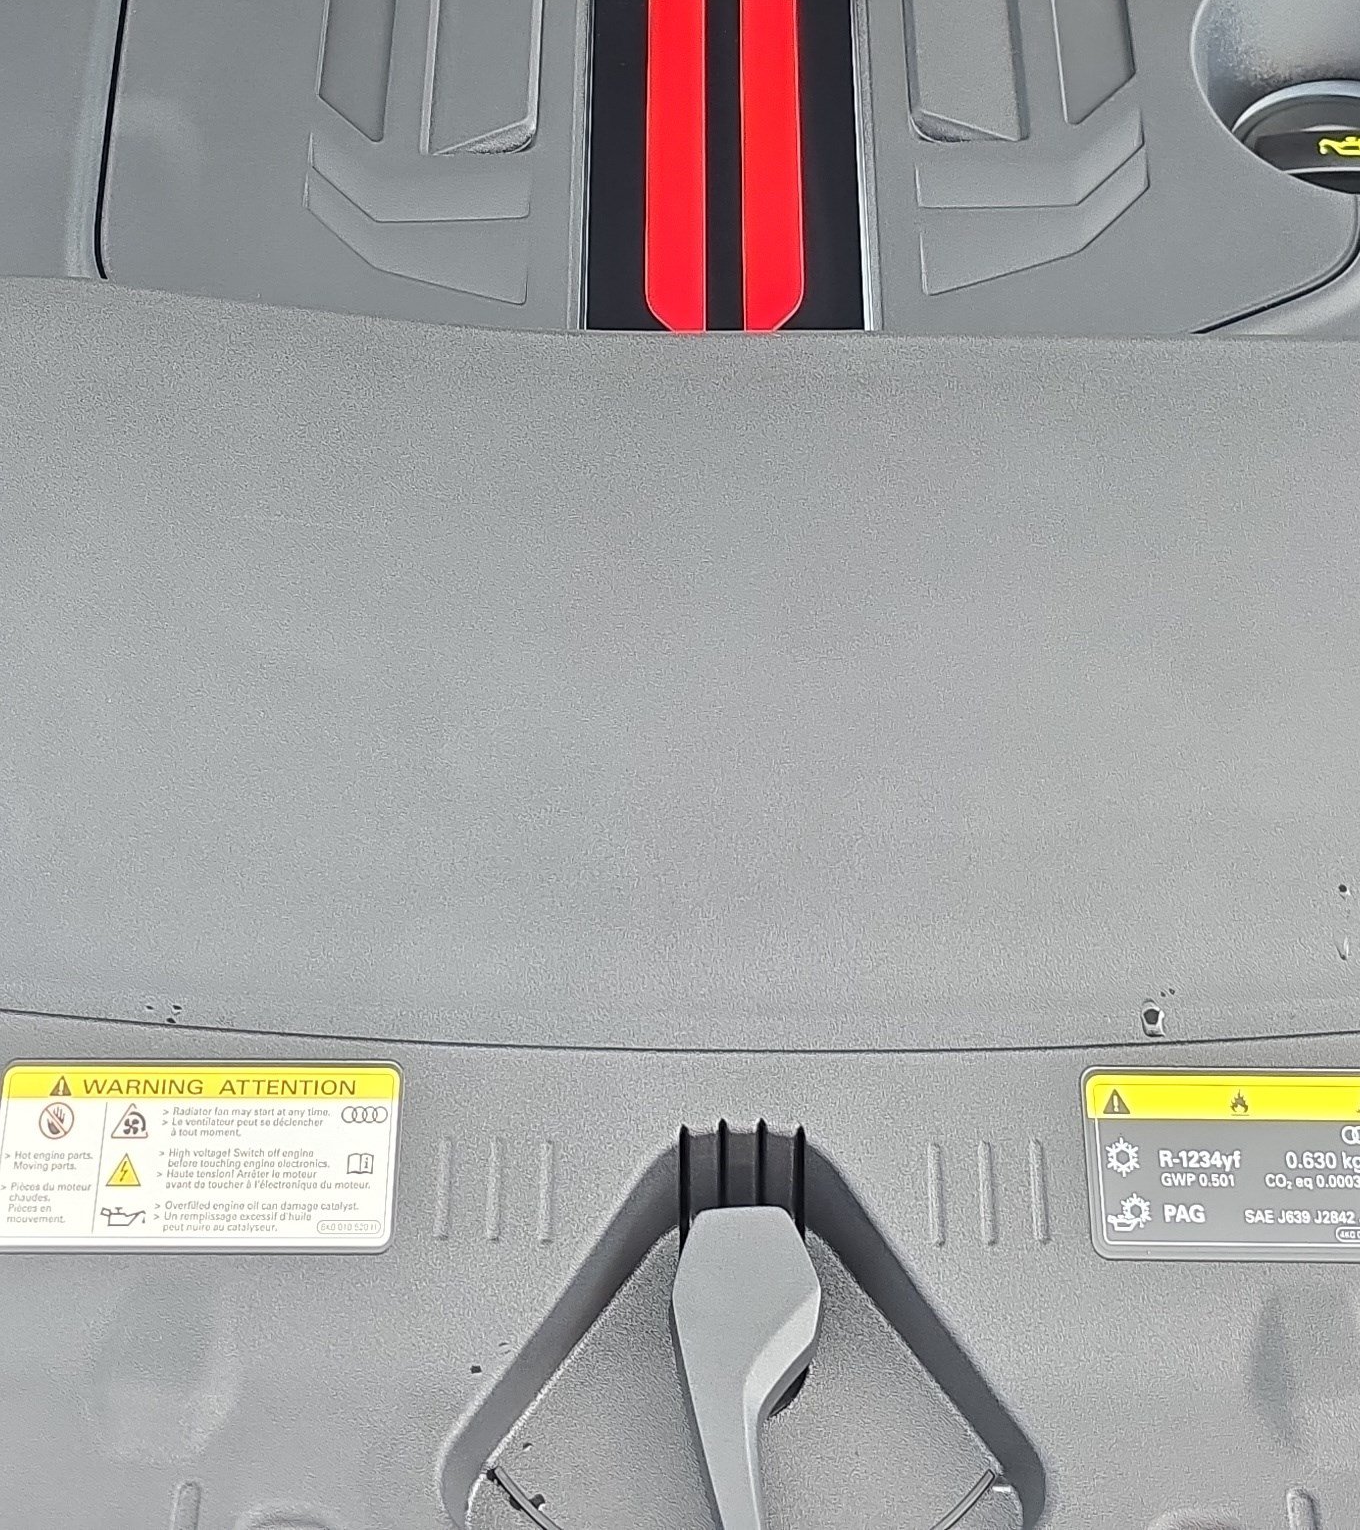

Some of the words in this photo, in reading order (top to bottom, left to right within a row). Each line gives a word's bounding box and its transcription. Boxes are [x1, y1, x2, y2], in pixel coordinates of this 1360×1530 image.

[83, 1079, 204, 1095] WARNING
[218, 1079, 357, 1095] ATTENTION
[173, 1107, 211, 1116] Radiator
[214, 1107, 229, 1116] fan
[231, 1109, 251, 1118] may
[254, 1107, 274, 1116] start
[277, 1108, 286, 1116] at
[288, 1109, 305, 1118] any
[172, 1117, 183, 1126] Le
[185, 1117, 234, 1127] ventilateur
[237, 1118, 257, 1127] peut
[273, 1117, 324, 1127] déclencher
[179, 1128, 197, 1137] tout
[15, 1151, 32, 1159] Hot
[34, 1151, 65, 1161] engine
[168, 1148, 190, 1159] High
[233, 1148, 265, 1158] Switch
[267, 1148, 281, 1158] off
[282, 1149, 314, 1159] engine
[13, 1162, 48, 1171] Moving
[167, 1159, 198, 1169] before
[200, 1159, 240, 1169] touching
[243, 1159, 275, 1169] engine
[1158, 1150, 1241, 1173] R-1234yf
[1285, 1151, 1337, 1170] 0.630
[166, 1169, 194, 1178] Haute
[271, 1170, 280, 1179] le
[283, 1170, 318, 1179] moteur
[165, 1180, 191, 1189] avant
[194, 1180, 206, 1189] de
[208, 1180, 244, 1189] toucher
[321, 1180, 333, 1190] du
[1161, 1173, 1196, 1187] GWP
[1199, 1173, 1235, 1187] 0.501
[1295, 1177, 1314, 1190] eq
[43, 1181, 55, 1191] du
[57, 1182, 92, 1191] moteur
[165, 1201, 211, 1211] Overfilled
[213, 1201, 245, 1212] engine
[247, 1201, 259, 1210] oil
[261, 1203, 278, 1211] can
[280, 1201, 319, 1212] damage
[164, 1212, 178, 1221] Un
[180, 1212, 237, 1222] remplissage
[239, 1212, 278, 1221] excessif
[1163, 1204, 1205, 1224] PAG
[1244, 1209, 1274, 1224] SAE
[1277, 1210, 1311, 1224] J639
[1314, 1210, 1356, 1225] J2842
[162, 1223, 184, 1233] peut
[186, 1223, 211, 1232] nuire
